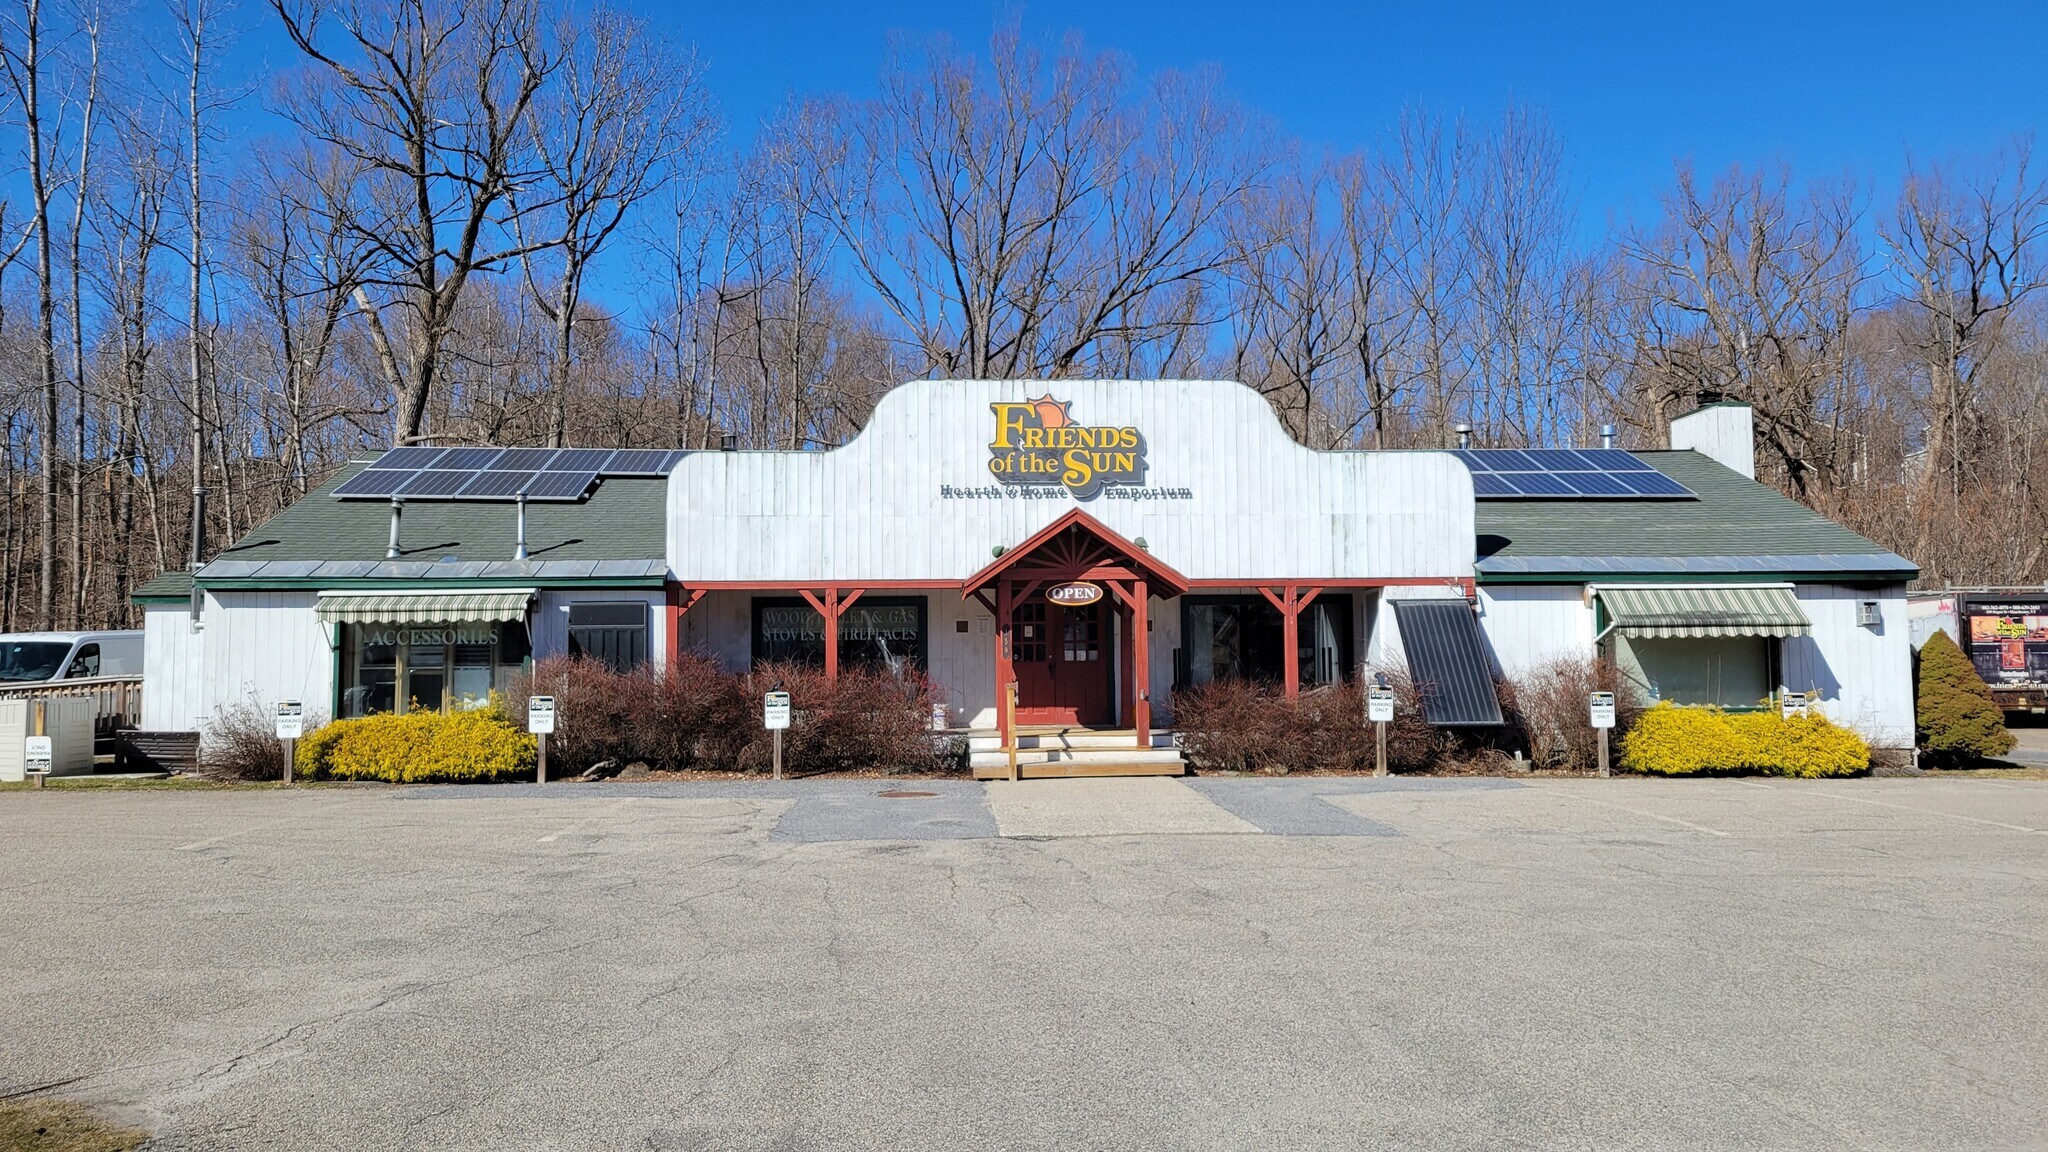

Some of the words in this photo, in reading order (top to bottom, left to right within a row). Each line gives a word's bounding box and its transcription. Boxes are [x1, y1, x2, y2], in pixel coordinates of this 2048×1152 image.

[989, 403, 1138, 448] FRIENDS
[990, 452, 1015, 473] of
[1019, 454, 1059, 473] the
[1062, 449, 1137, 487] SUN
[941, 485, 1001, 498] Hearth
[1005, 485, 1018, 498] &
[1020, 485, 1068, 499] Home
[1104, 485, 1193, 500] Emporium
[1052, 587, 1096, 599] OPEN
[817, 611, 867, 623] LLET
[872, 611, 884, 623] &
[889, 610, 916, 623] GAS
[370, 629, 499, 646] ACCESSORIES
[764, 628, 816, 641] STOVES
[838, 628, 917, 641] FIREPLACES
